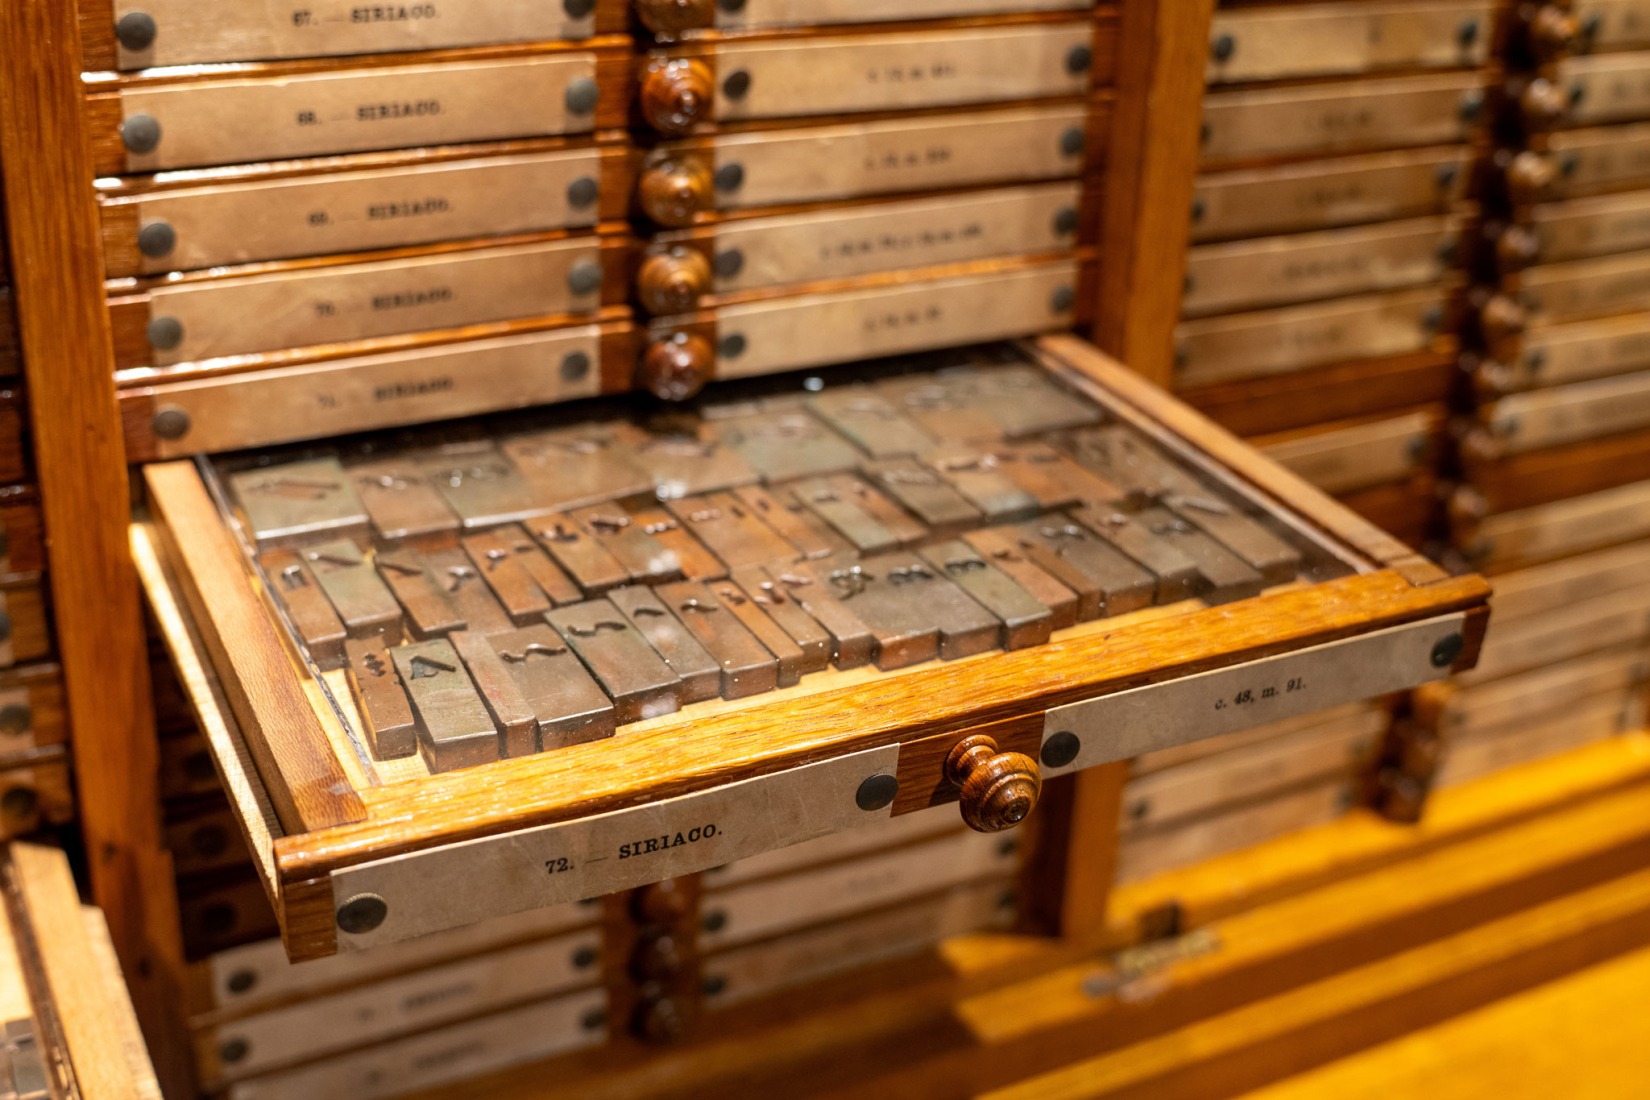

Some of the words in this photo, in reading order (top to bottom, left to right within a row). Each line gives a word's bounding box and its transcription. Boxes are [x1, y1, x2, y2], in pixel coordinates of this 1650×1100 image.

[351, 4, 441, 24] SIRIACO.
[1234, 689, 1254, 704] 48,
[1261, 687, 1279, 699] m.
[1286, 677, 1307, 692] 91.
[545, 857, 574, 874] 72.
[618, 824, 722, 860] SIRIACO.
